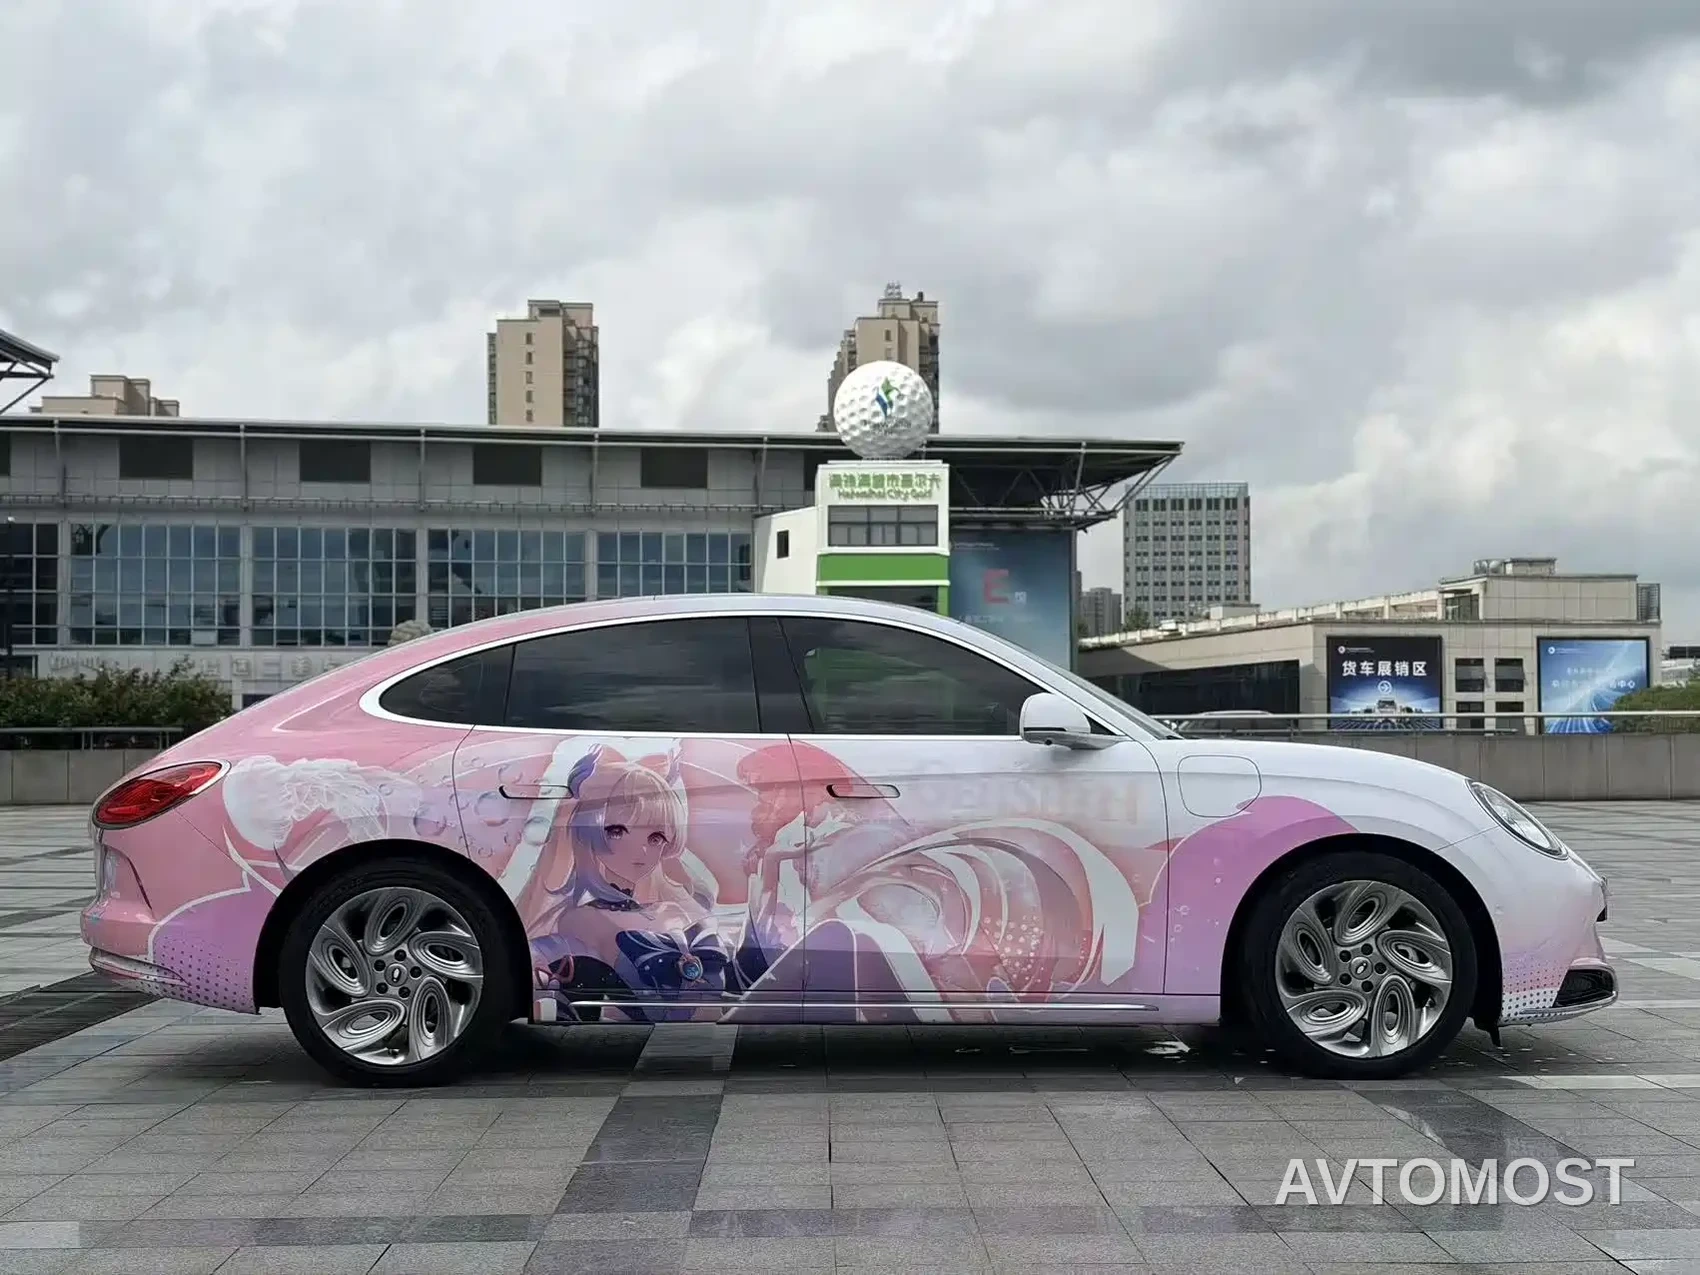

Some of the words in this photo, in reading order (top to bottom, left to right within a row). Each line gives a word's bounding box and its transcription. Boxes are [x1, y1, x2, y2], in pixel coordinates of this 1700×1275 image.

[1342, 660, 1427, 677] 货车展销区
